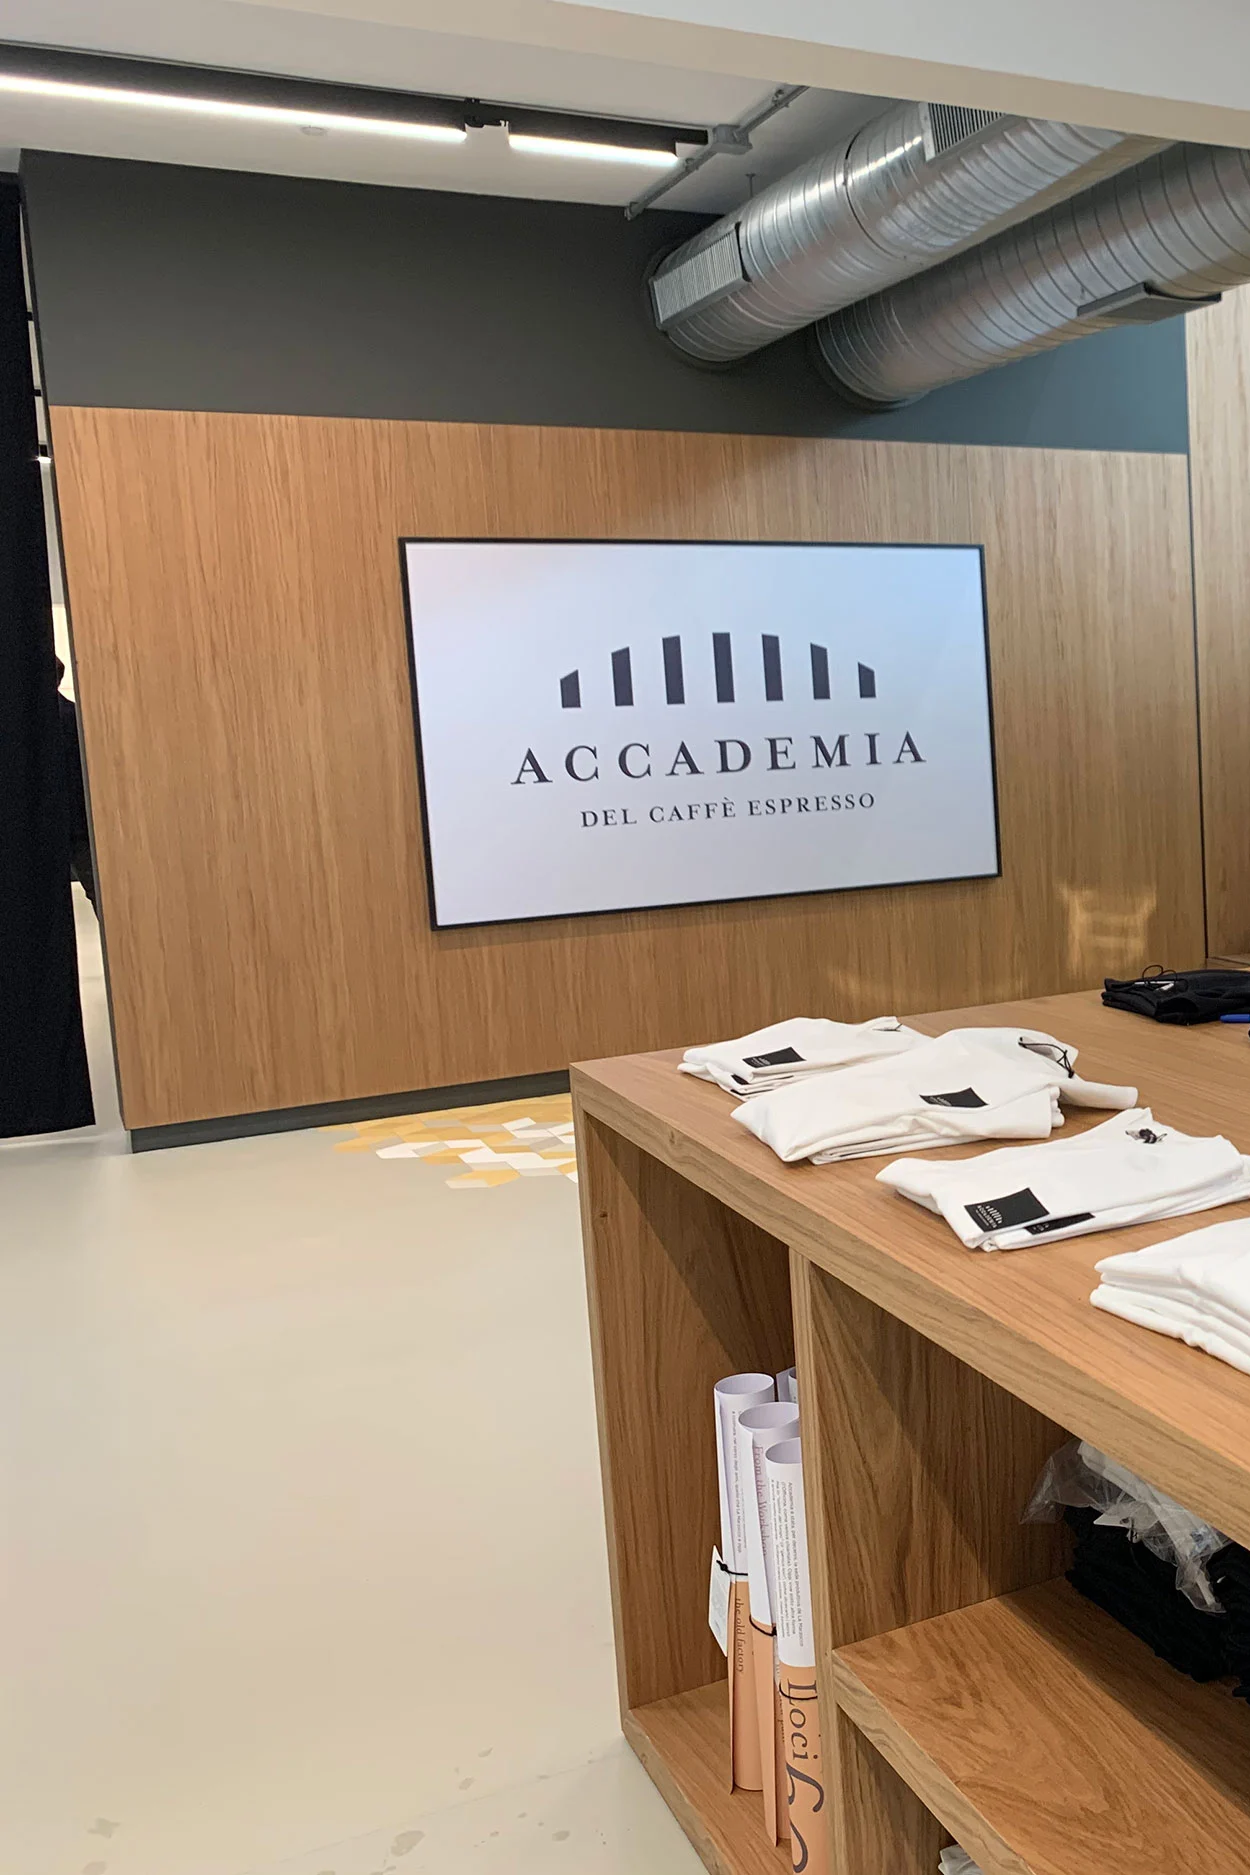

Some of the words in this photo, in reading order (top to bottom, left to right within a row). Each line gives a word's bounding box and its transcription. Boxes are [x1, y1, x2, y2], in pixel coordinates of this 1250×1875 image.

[510, 731, 926, 785] ACCADEMIA
[581, 808, 636, 828] DEL
[649, 796, 736, 823] CAFFÈ
[748, 792, 875, 816] ESPRESSO
[753, 1445, 764, 1475] From
[757, 1480, 767, 1498] the
[735, 1598, 745, 1614] the
[736, 1617, 746, 1634] old
[737, 1638, 746, 1674] factory
[787, 1679, 818, 1760] Loci
